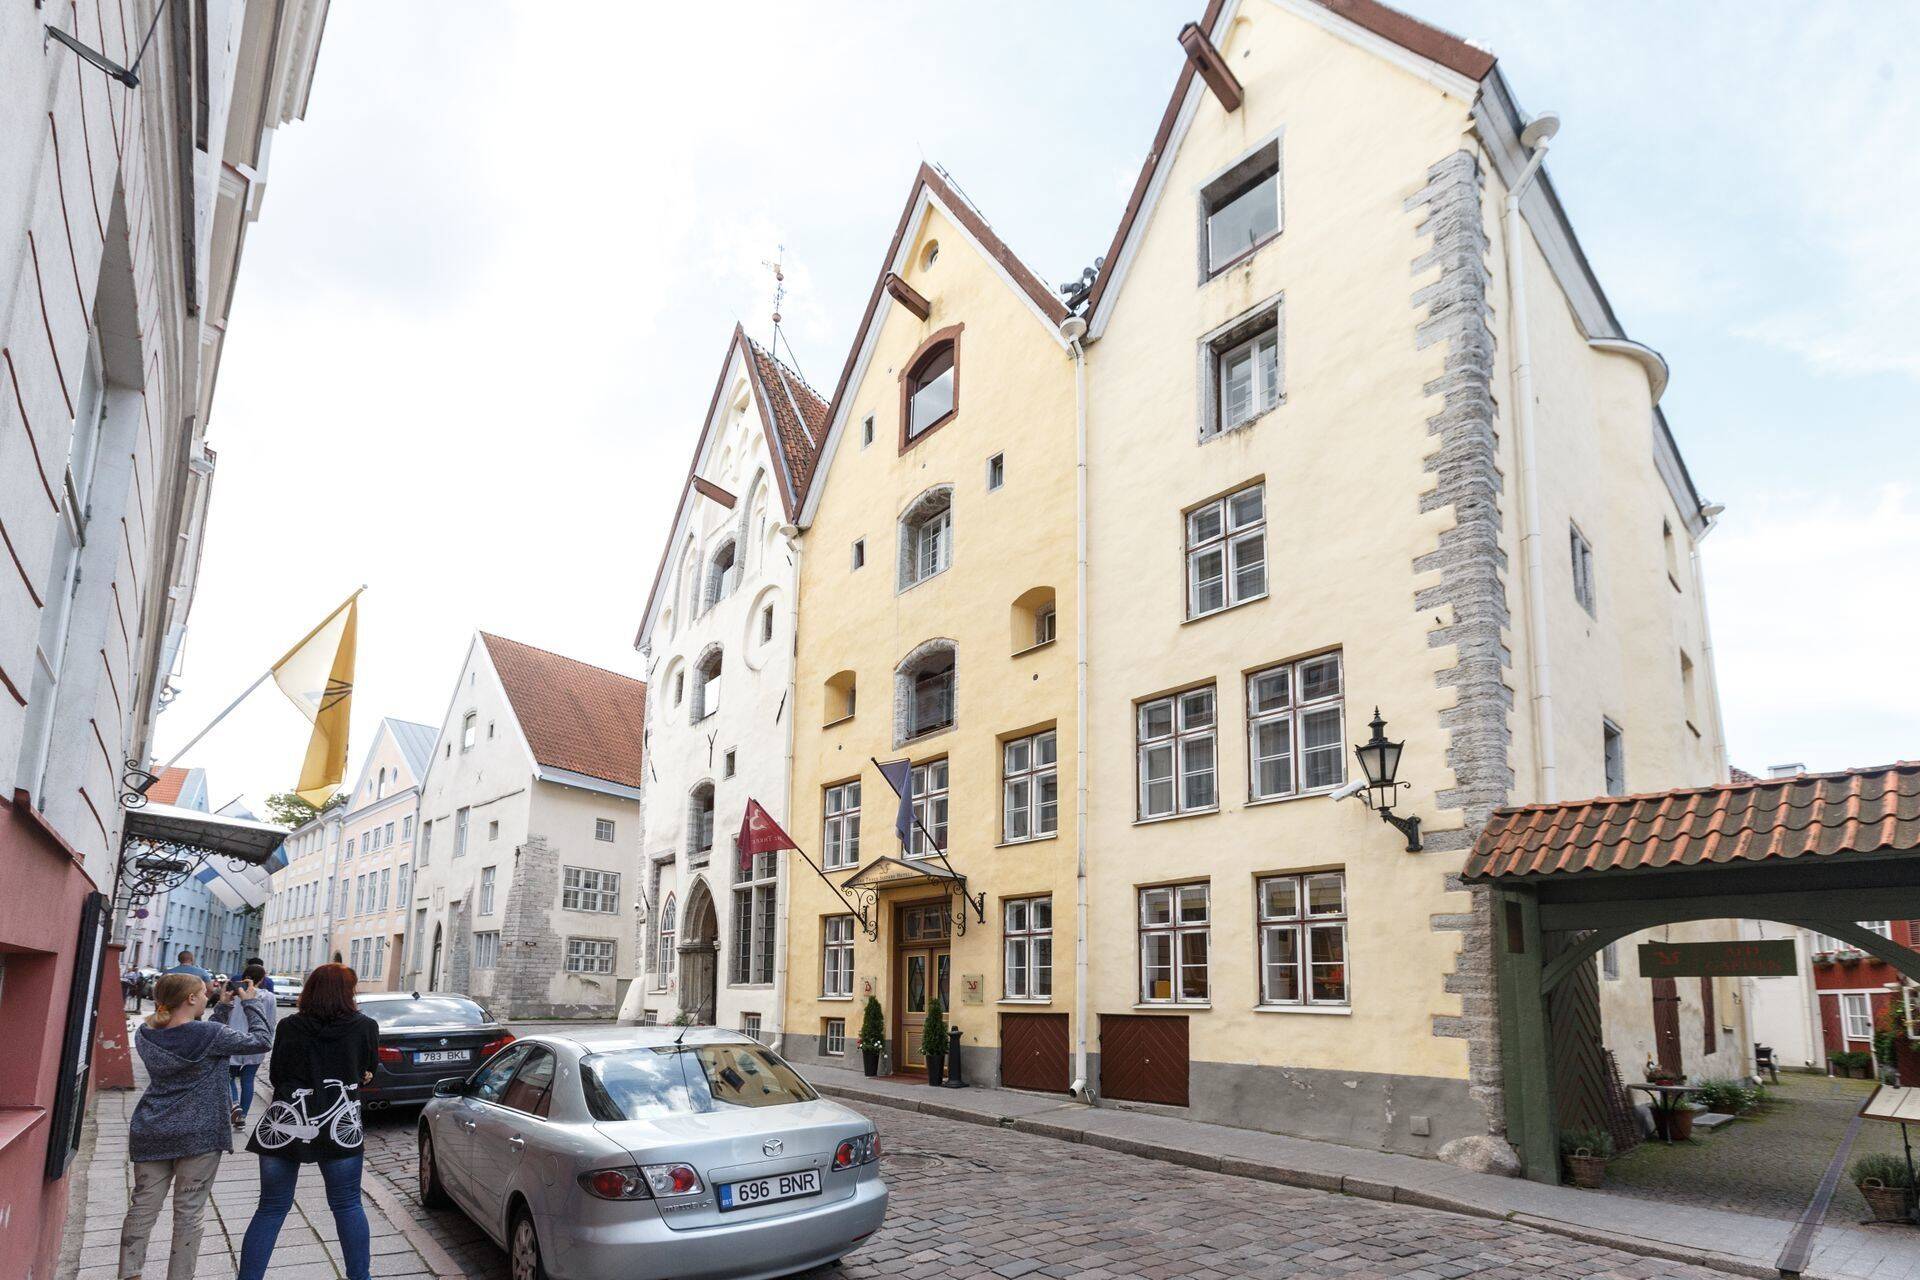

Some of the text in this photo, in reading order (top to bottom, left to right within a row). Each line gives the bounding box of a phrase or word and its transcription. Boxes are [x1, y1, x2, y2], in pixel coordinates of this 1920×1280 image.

[423, 1051, 467, 1062] 783 BKL
[738, 1173, 815, 1201] 696 BNR
[722, 1198, 733, 1206] EST
